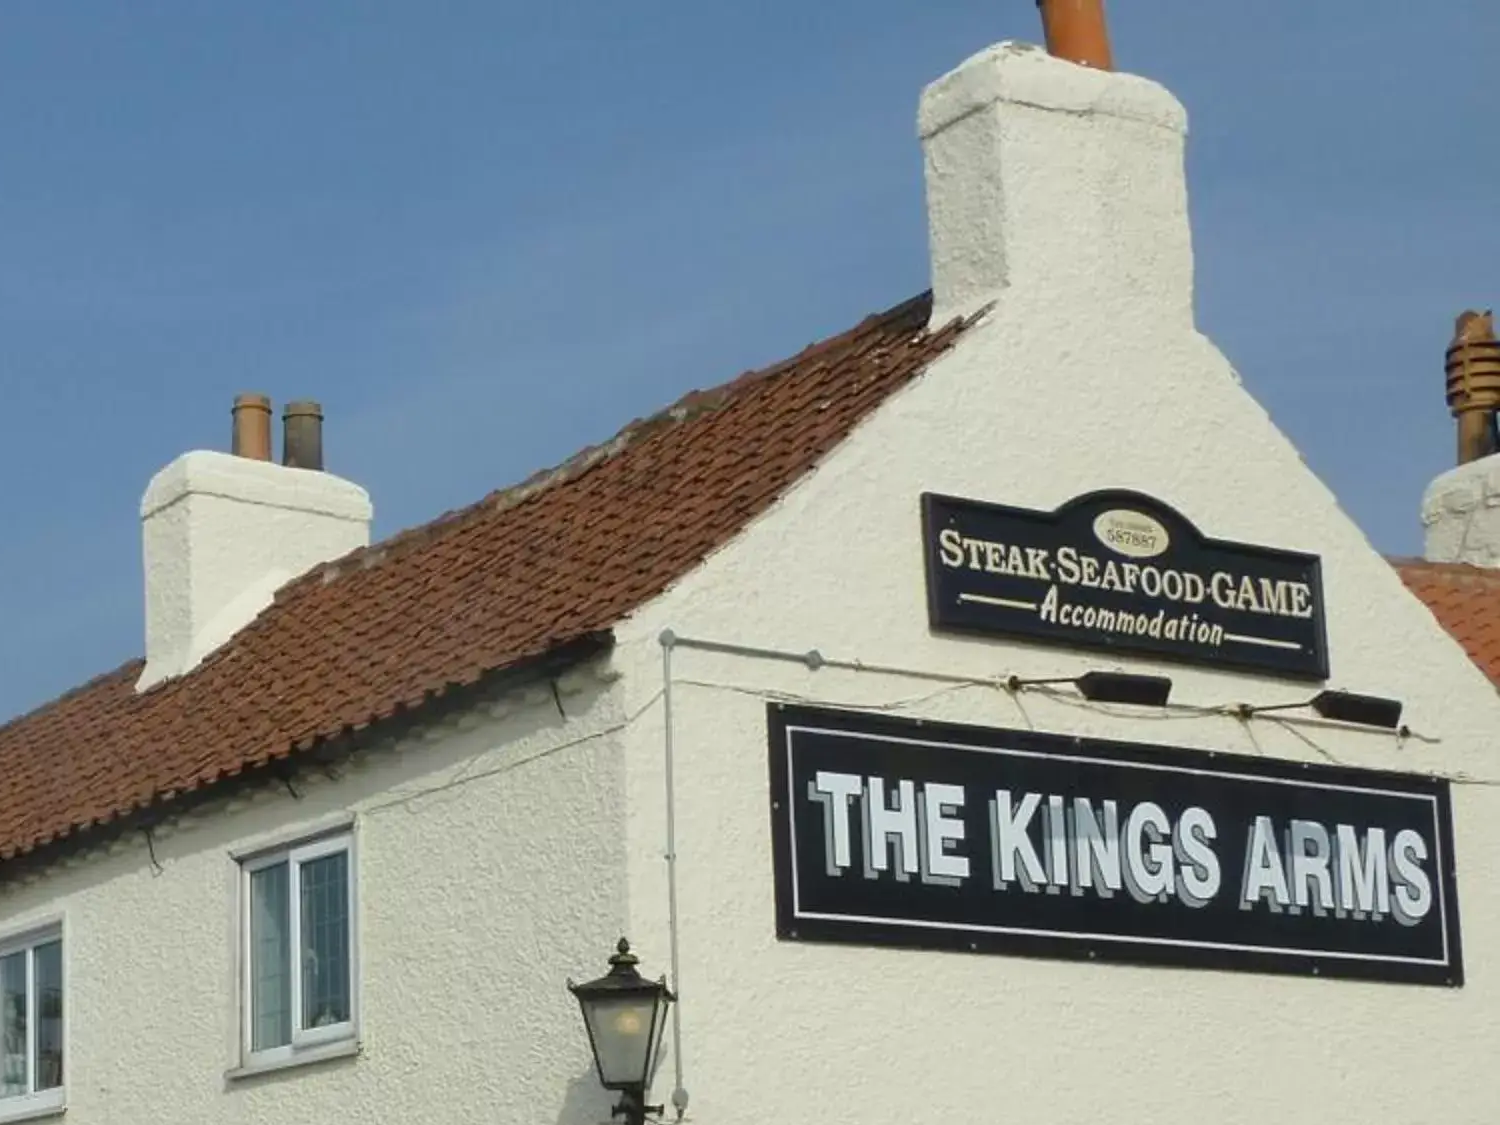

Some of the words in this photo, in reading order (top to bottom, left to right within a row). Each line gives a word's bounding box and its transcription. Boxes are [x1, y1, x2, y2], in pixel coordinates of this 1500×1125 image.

[1040, 585, 1223, 646] Accommodation
[808, 770, 970, 886] THE
[989, 789, 1222, 909] KINGS
[1238, 815, 1433, 927] ARMS
